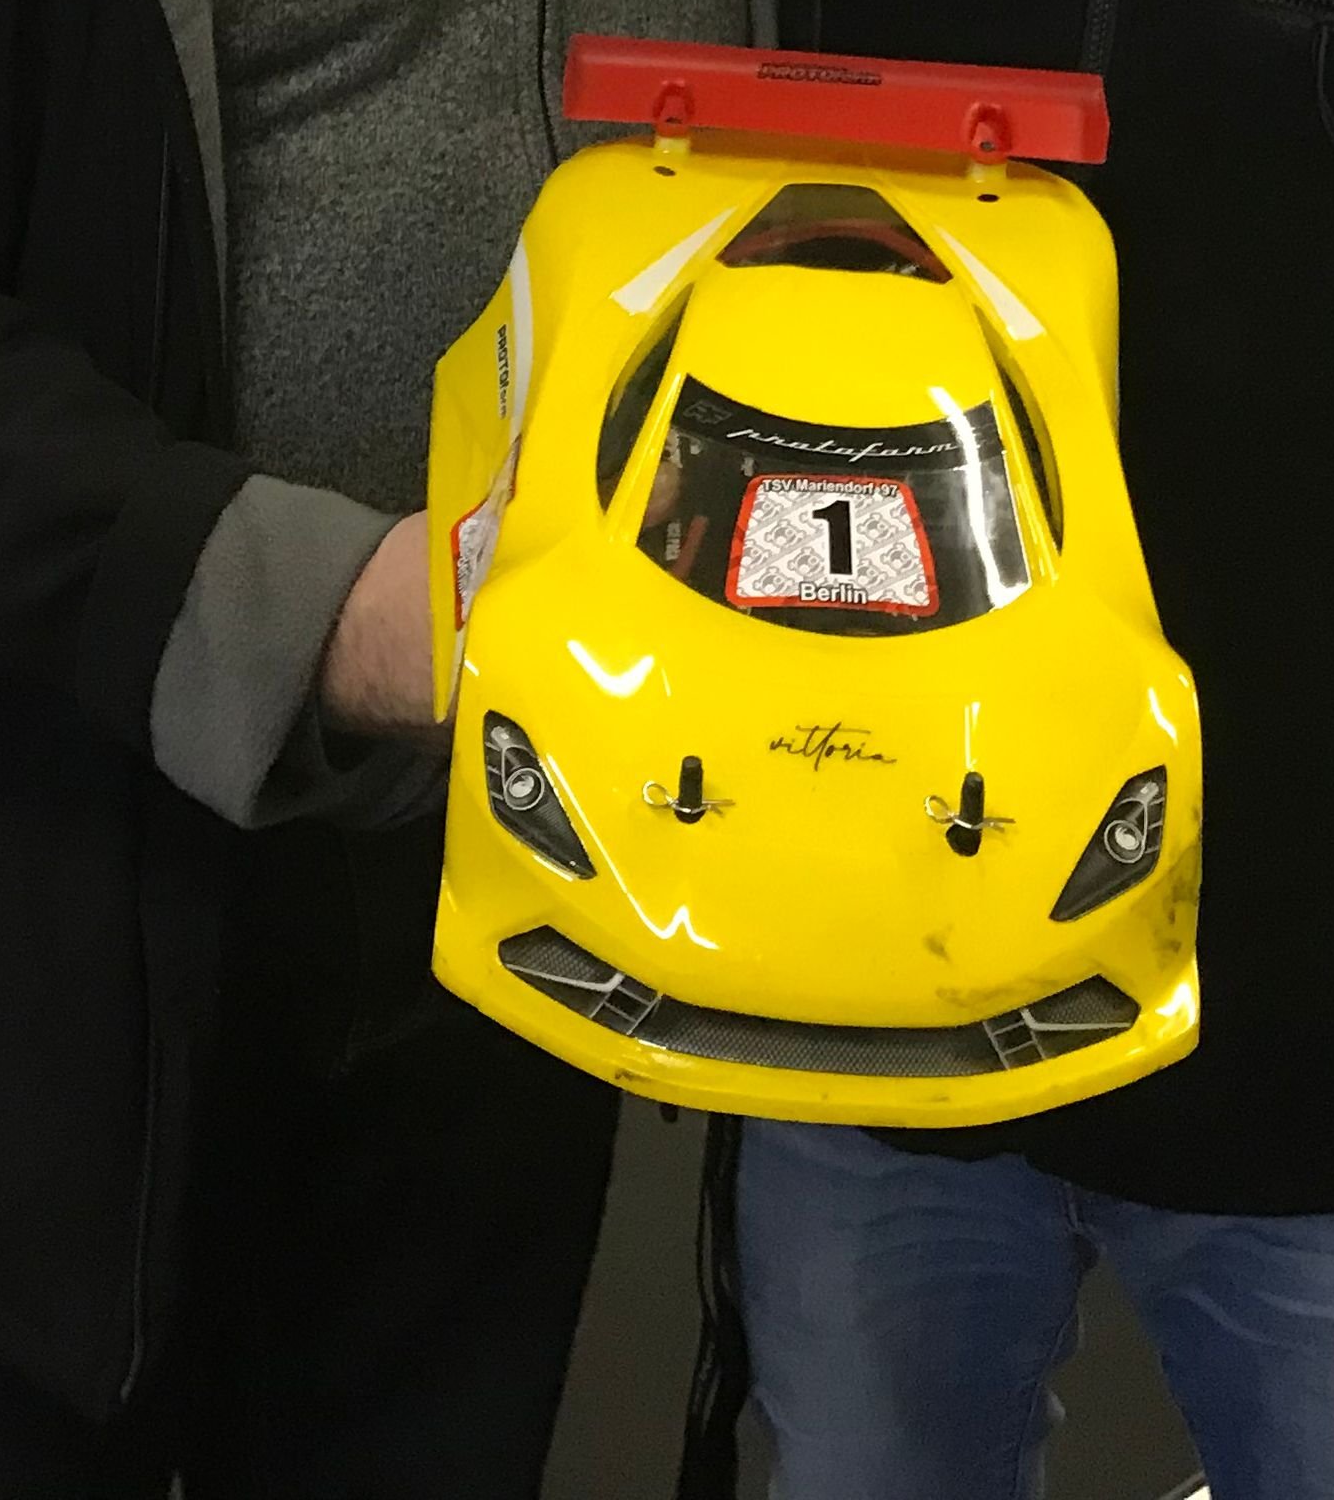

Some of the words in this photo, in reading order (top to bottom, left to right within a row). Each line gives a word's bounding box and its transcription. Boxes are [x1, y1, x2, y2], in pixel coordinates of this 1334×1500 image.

[725, 428, 966, 463] protoform
[763, 479, 792, 492] TSV
[796, 479, 875, 494] Mariendorf
[812, 500, 853, 576] 1
[800, 581, 867, 604] Berlin
[769, 721, 898, 772] vittoria
